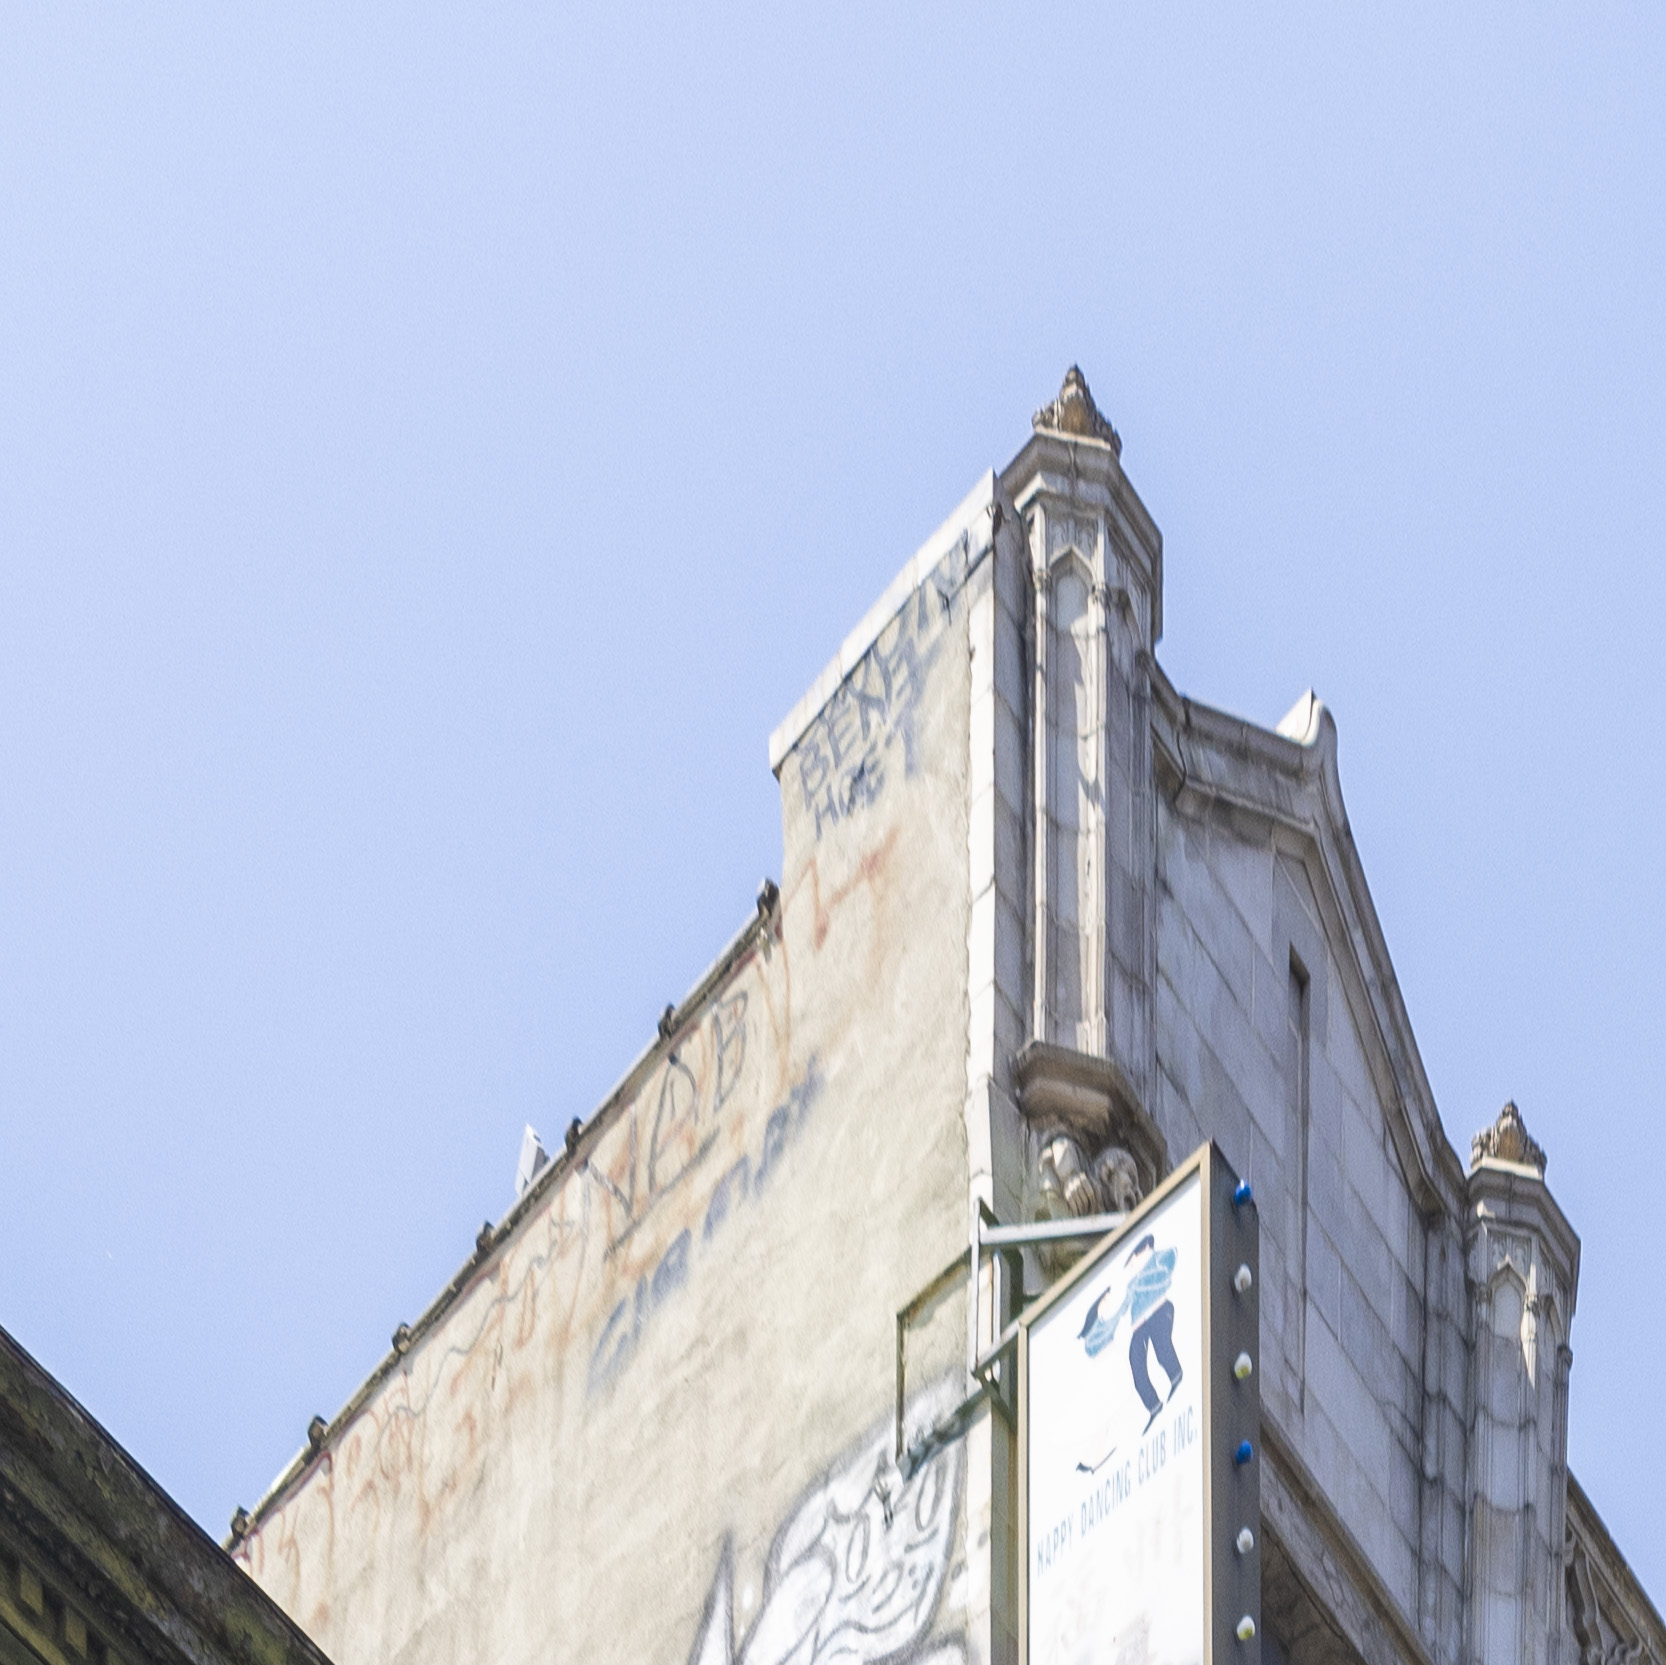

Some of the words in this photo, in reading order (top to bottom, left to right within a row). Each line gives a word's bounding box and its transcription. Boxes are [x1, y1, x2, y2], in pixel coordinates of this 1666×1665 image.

[1037, 1513, 1073, 1578] HAPPY
[1080, 1459, 1130, 1537] DANCING
[1138, 1429, 1166, 1486] CLUB
[1173, 1405, 1198, 1457] INC.
